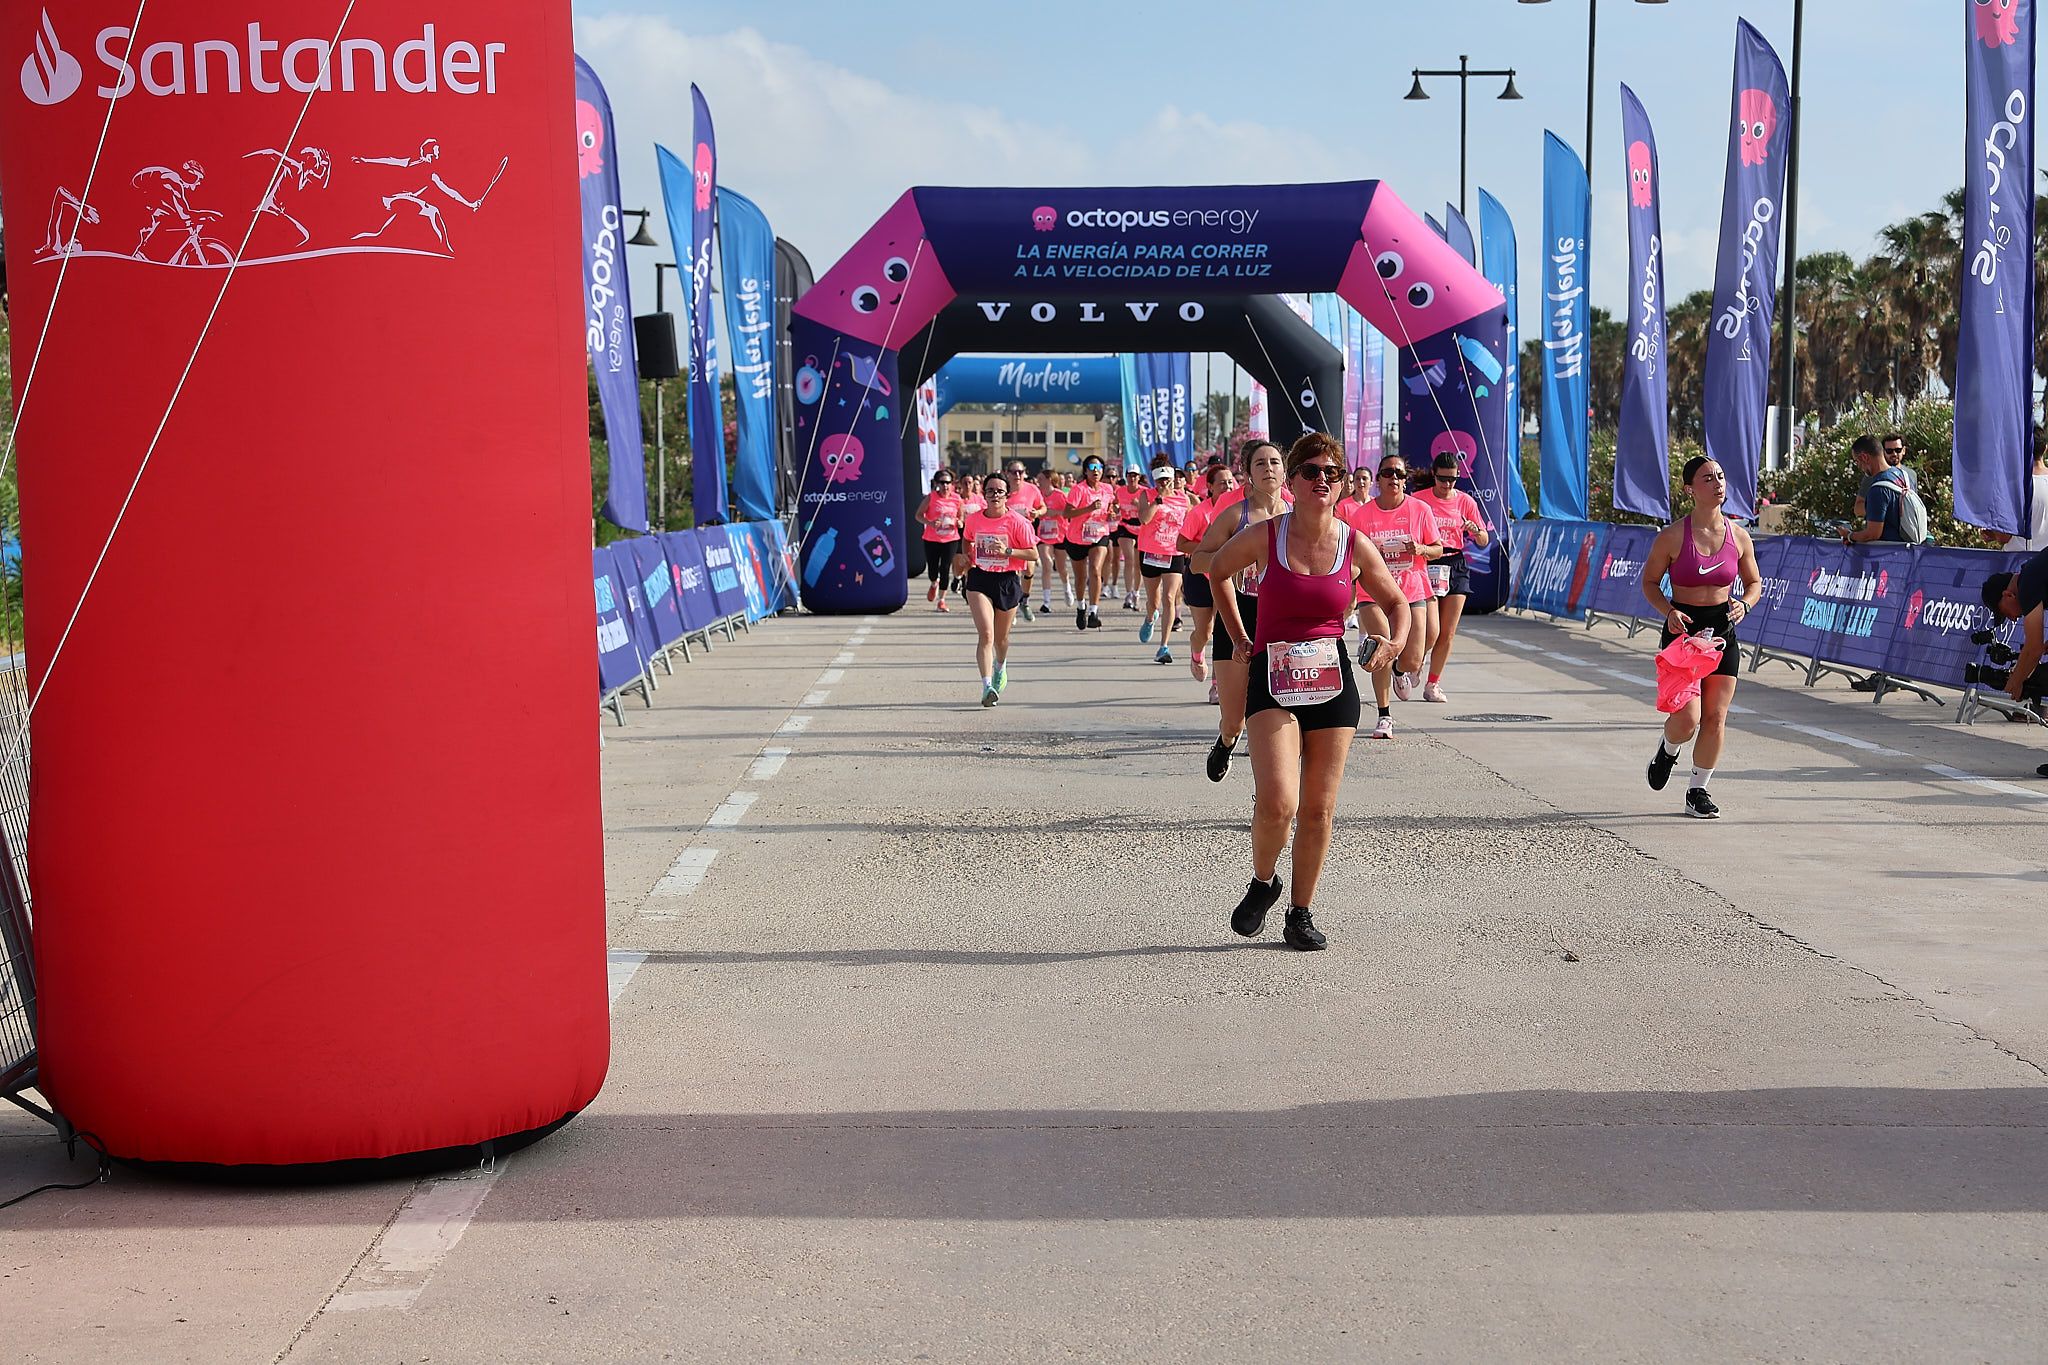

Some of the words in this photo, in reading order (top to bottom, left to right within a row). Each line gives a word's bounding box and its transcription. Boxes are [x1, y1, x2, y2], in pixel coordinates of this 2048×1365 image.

[95, 22, 505, 98] Santander
[1067, 208, 1170, 232] octopus
[1173, 209, 1259, 233] energy
[1016, 244, 1041, 259] LA
[1046, 241, 1129, 259] ENERGÍA
[1133, 244, 1186, 259] PARA
[1190, 244, 1269, 259] CORRER
[1014, 265, 1028, 278] A
[1032, 265, 1057, 278] LA
[1063, 265, 1171, 278] VELOCIDAD
[1175, 265, 1201, 278] DE
[1205, 264, 1230, 277] LA
[1234, 264, 1272, 277] LUZ
[977, 302, 1205, 323] VOLVO
[998, 362, 1080, 398] Marlene
[803, 492, 847, 504] octopus
[847, 490, 887, 504] energy
[1466, 488, 1497, 502] nergy
[1923, 597, 1975, 636] octopus
[1291, 669, 1319, 680] 016
